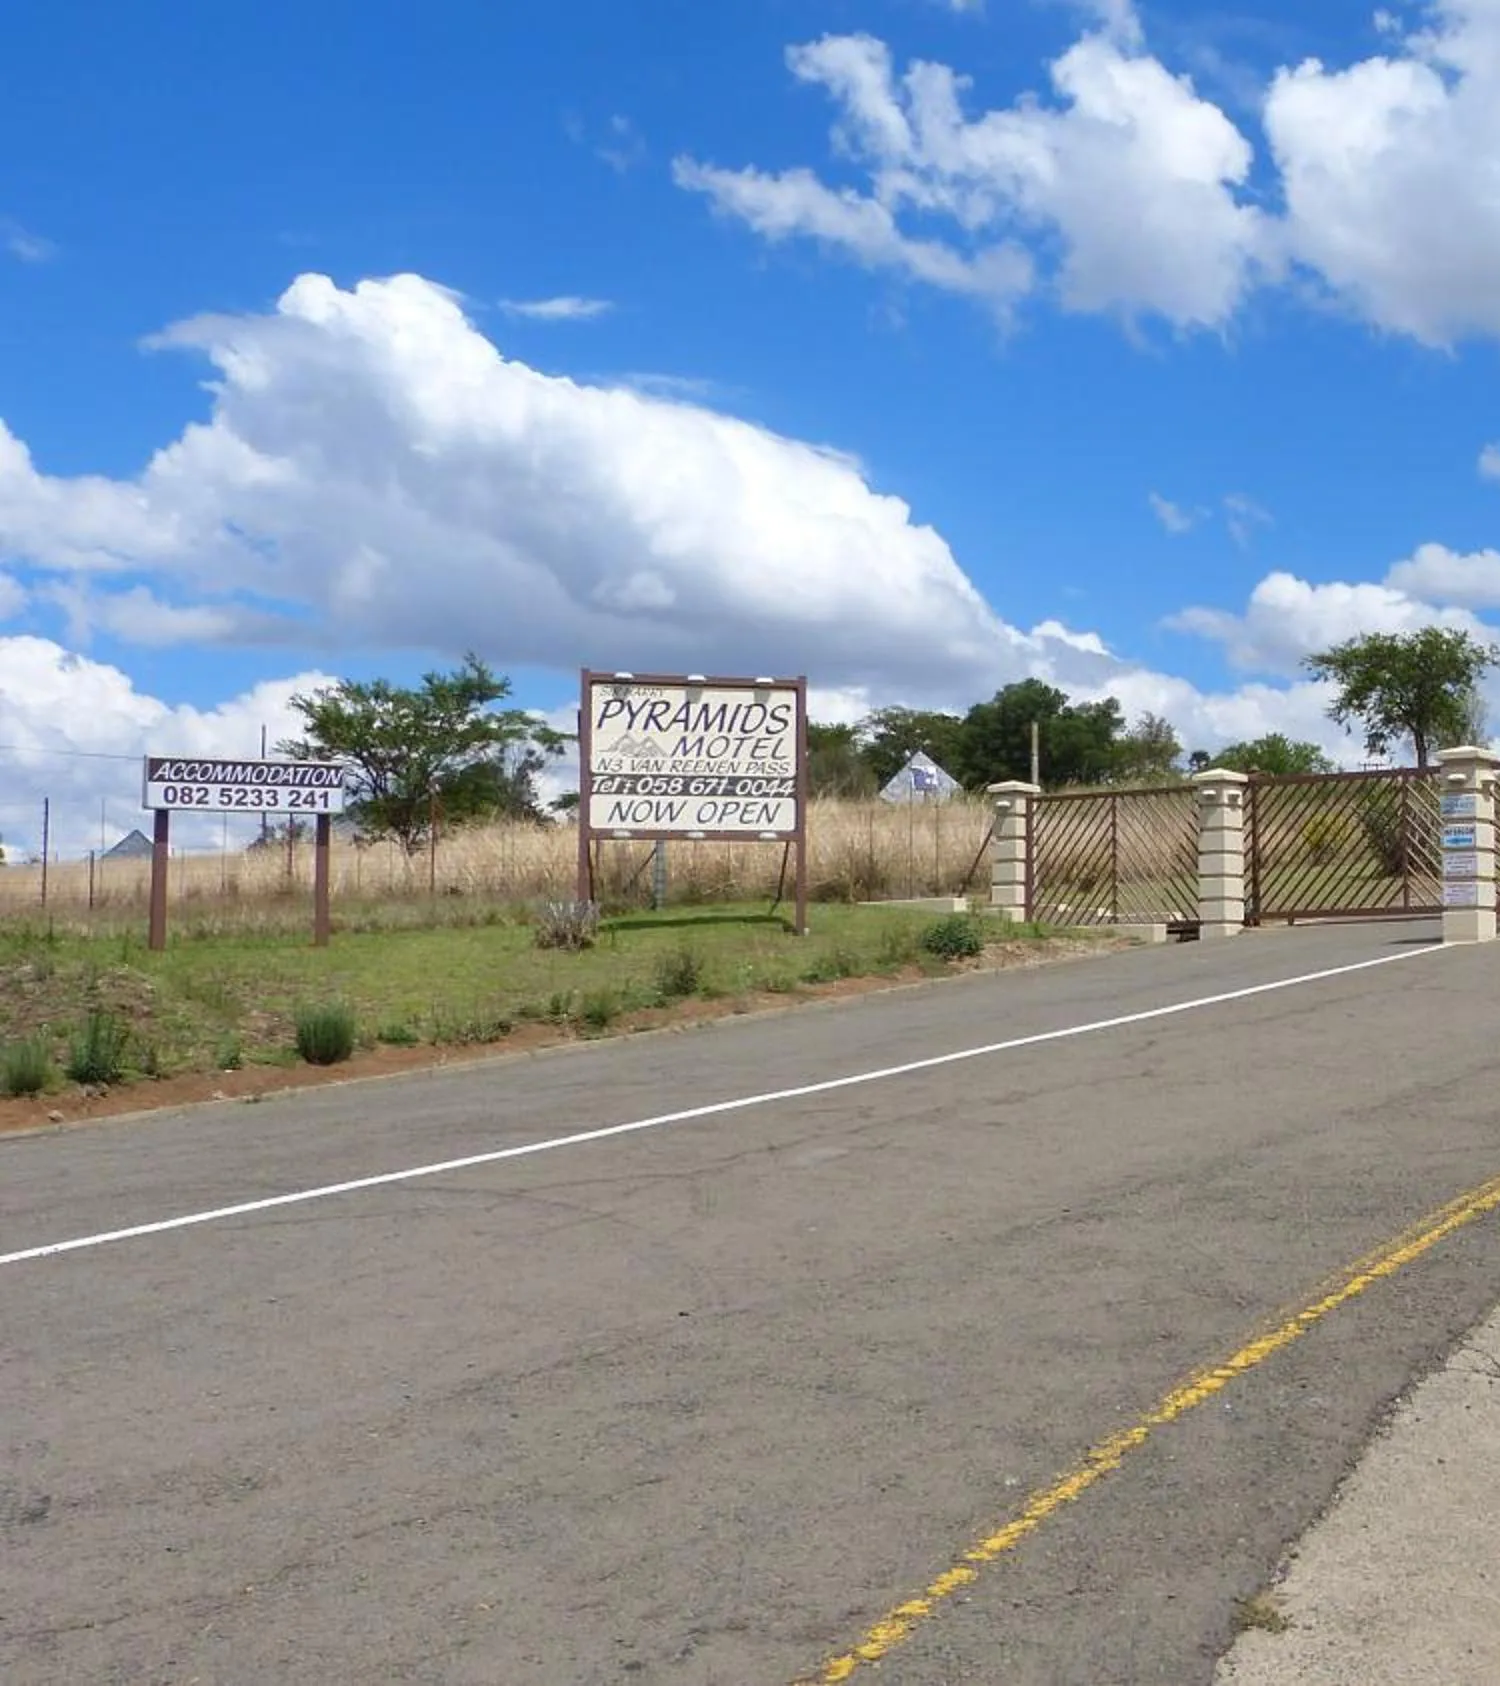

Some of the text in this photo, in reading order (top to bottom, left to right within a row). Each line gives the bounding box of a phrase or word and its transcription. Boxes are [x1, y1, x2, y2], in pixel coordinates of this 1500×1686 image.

[597, 699, 791, 735] PYRAMIDS
[671, 735, 788, 761] MOTEL
[153, 762, 343, 785] ACCOMMODATION
[597, 759, 789, 774] N3 VAN REENEN PASS
[163, 785, 330, 808] 082 5233 241
[637, 777, 683, 795] 058
[608, 801, 780, 824] NOW OPEN
